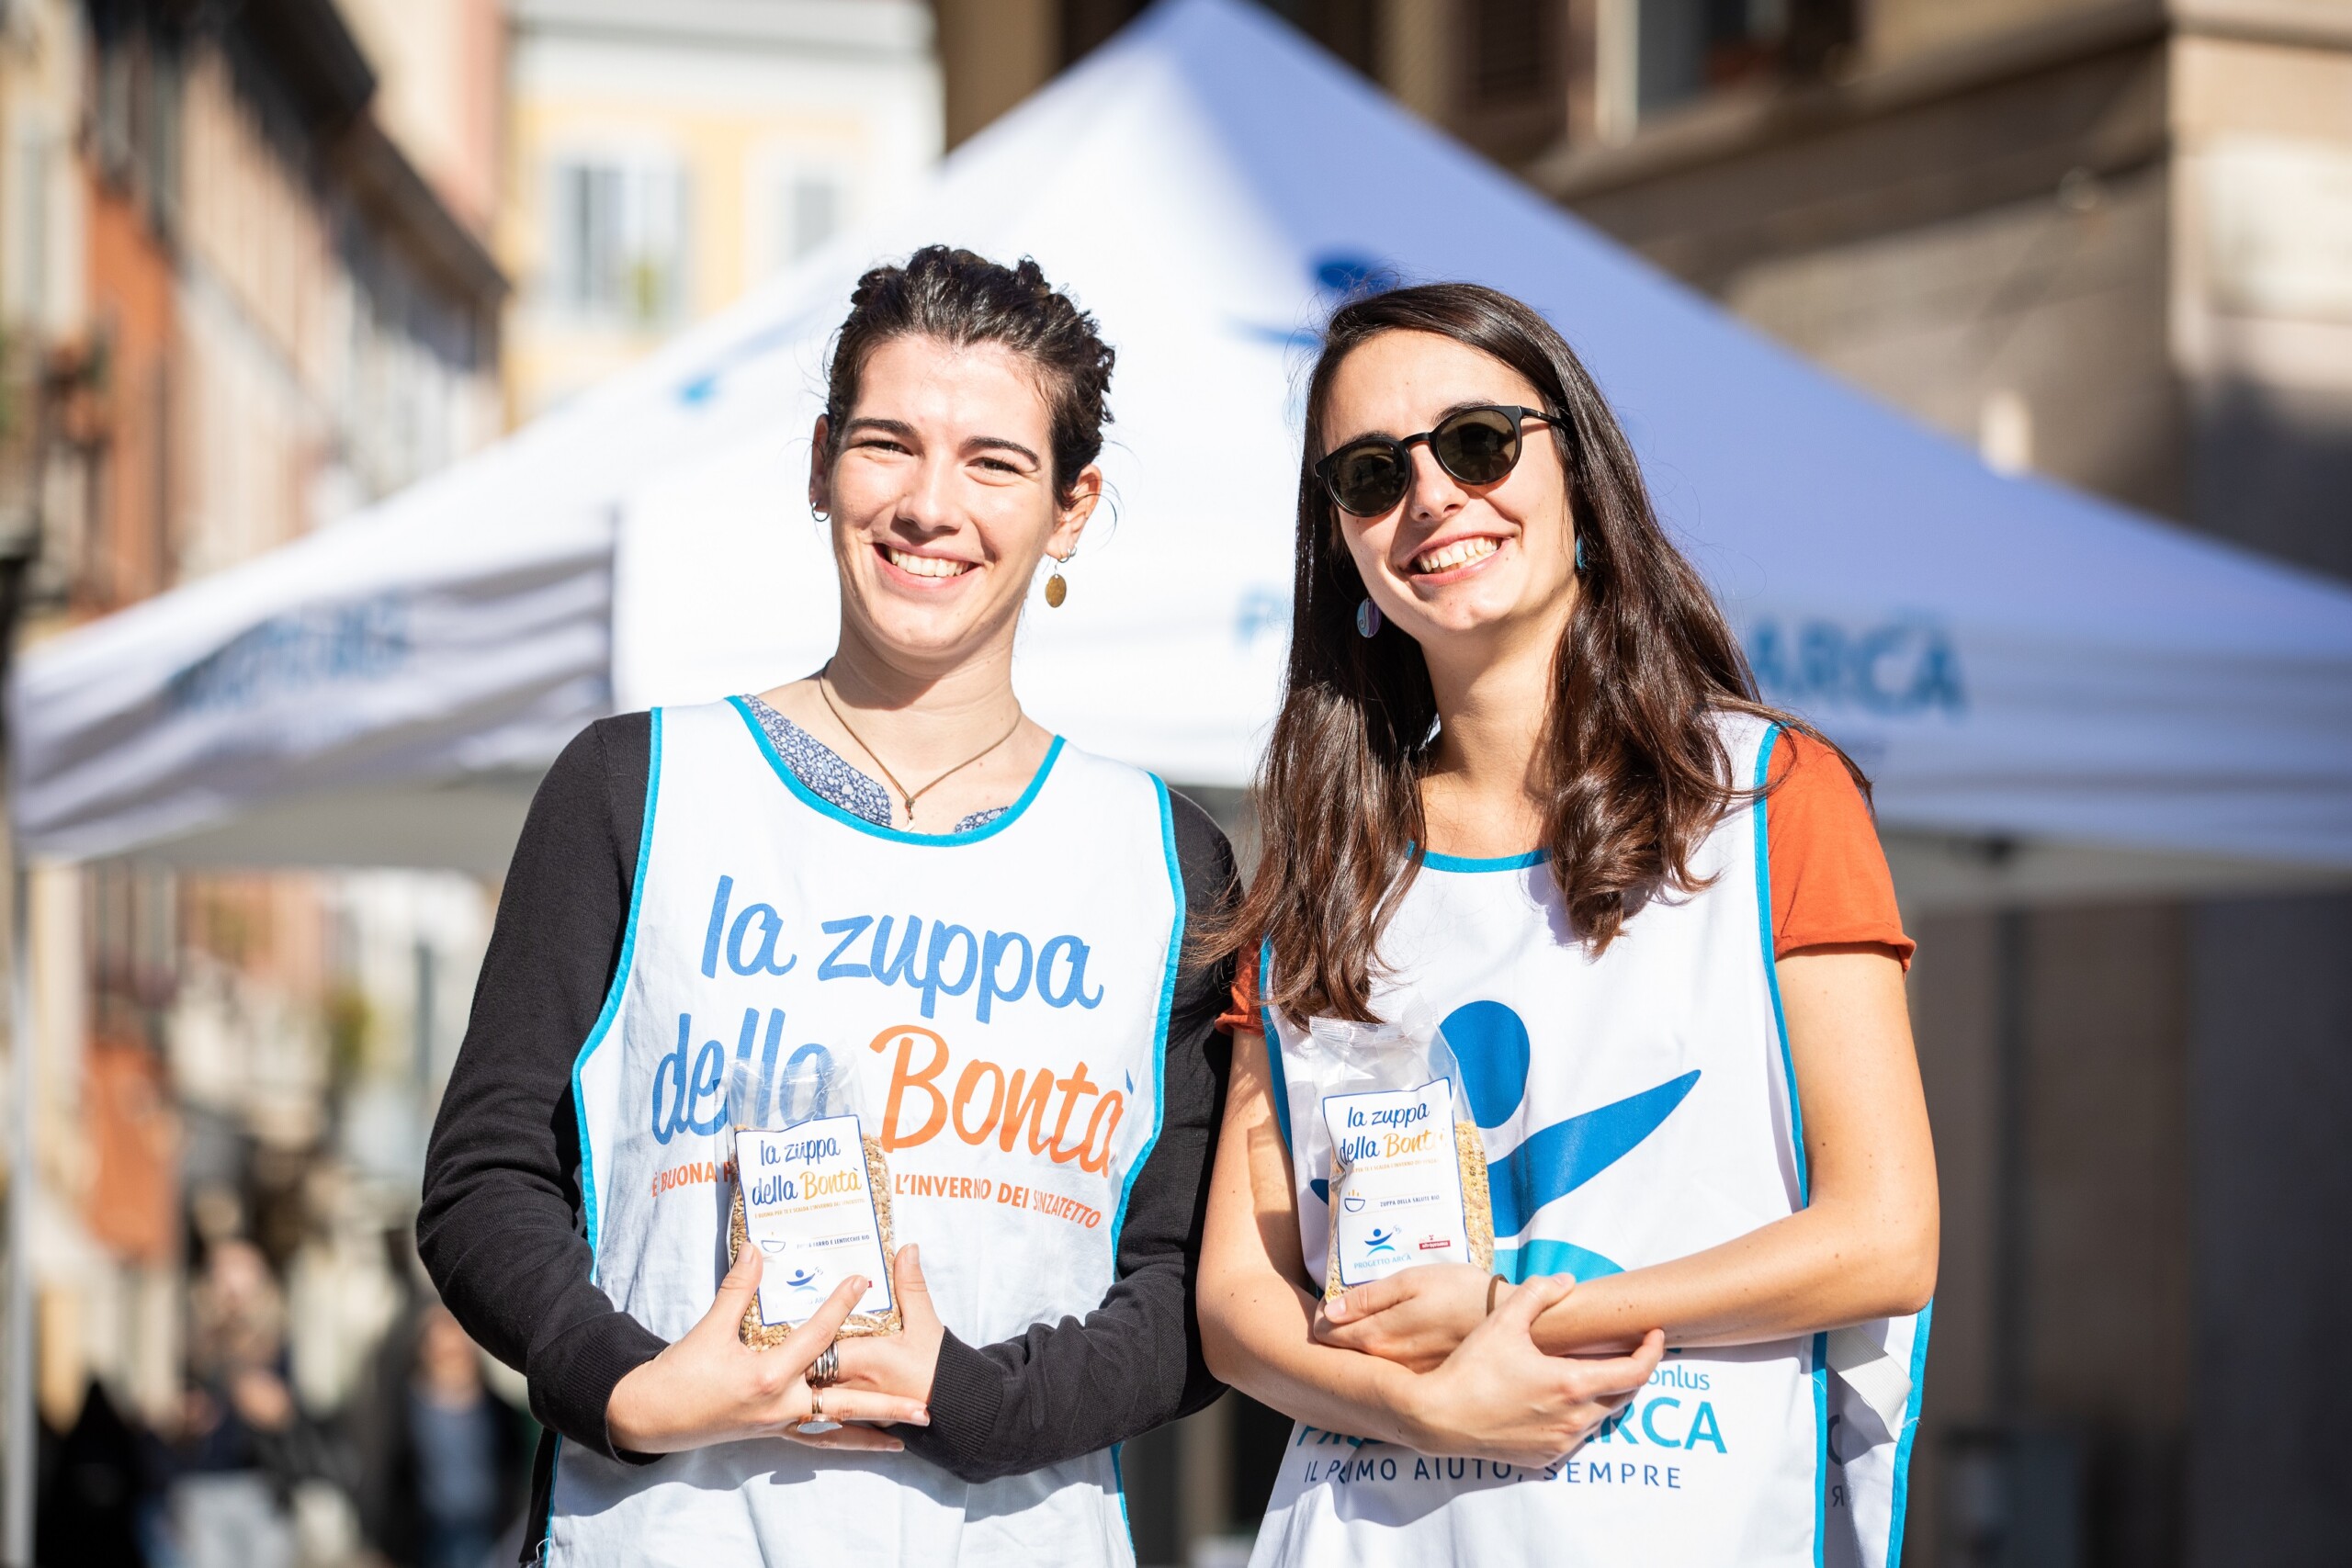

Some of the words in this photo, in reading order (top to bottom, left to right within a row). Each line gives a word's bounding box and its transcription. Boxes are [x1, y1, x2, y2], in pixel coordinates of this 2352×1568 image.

[701, 874, 797, 979] la
[817, 914, 1104, 1024] zuppa
[651, 1008, 849, 1145] della
[869, 1024, 1134, 1179] Bontà
[1347, 1106, 1367, 1128] la
[1371, 1102, 1430, 1129] zuppa
[761, 1140, 781, 1166] la
[784, 1137, 841, 1166] zuppa
[1340, 1135, 1380, 1165] della
[660, 1161, 718, 1193] BUONA
[752, 1175, 798, 1206] della
[799, 1167, 862, 1201] Bontà
[895, 1173, 992, 1200] L'INVERNO
[997, 1182, 1030, 1209] DEI
[1032, 1190, 1102, 1229] SNZATETTO
[1353, 1258, 1390, 1269] PROGETTO
[1392, 1252, 1411, 1264] ARCA
[1648, 1365, 1710, 1391] onlus
[1584, 1396, 1728, 1454] RCA
[1303, 1459, 1317, 1483] IL
[1544, 1461, 1681, 1489] SEMPRE
